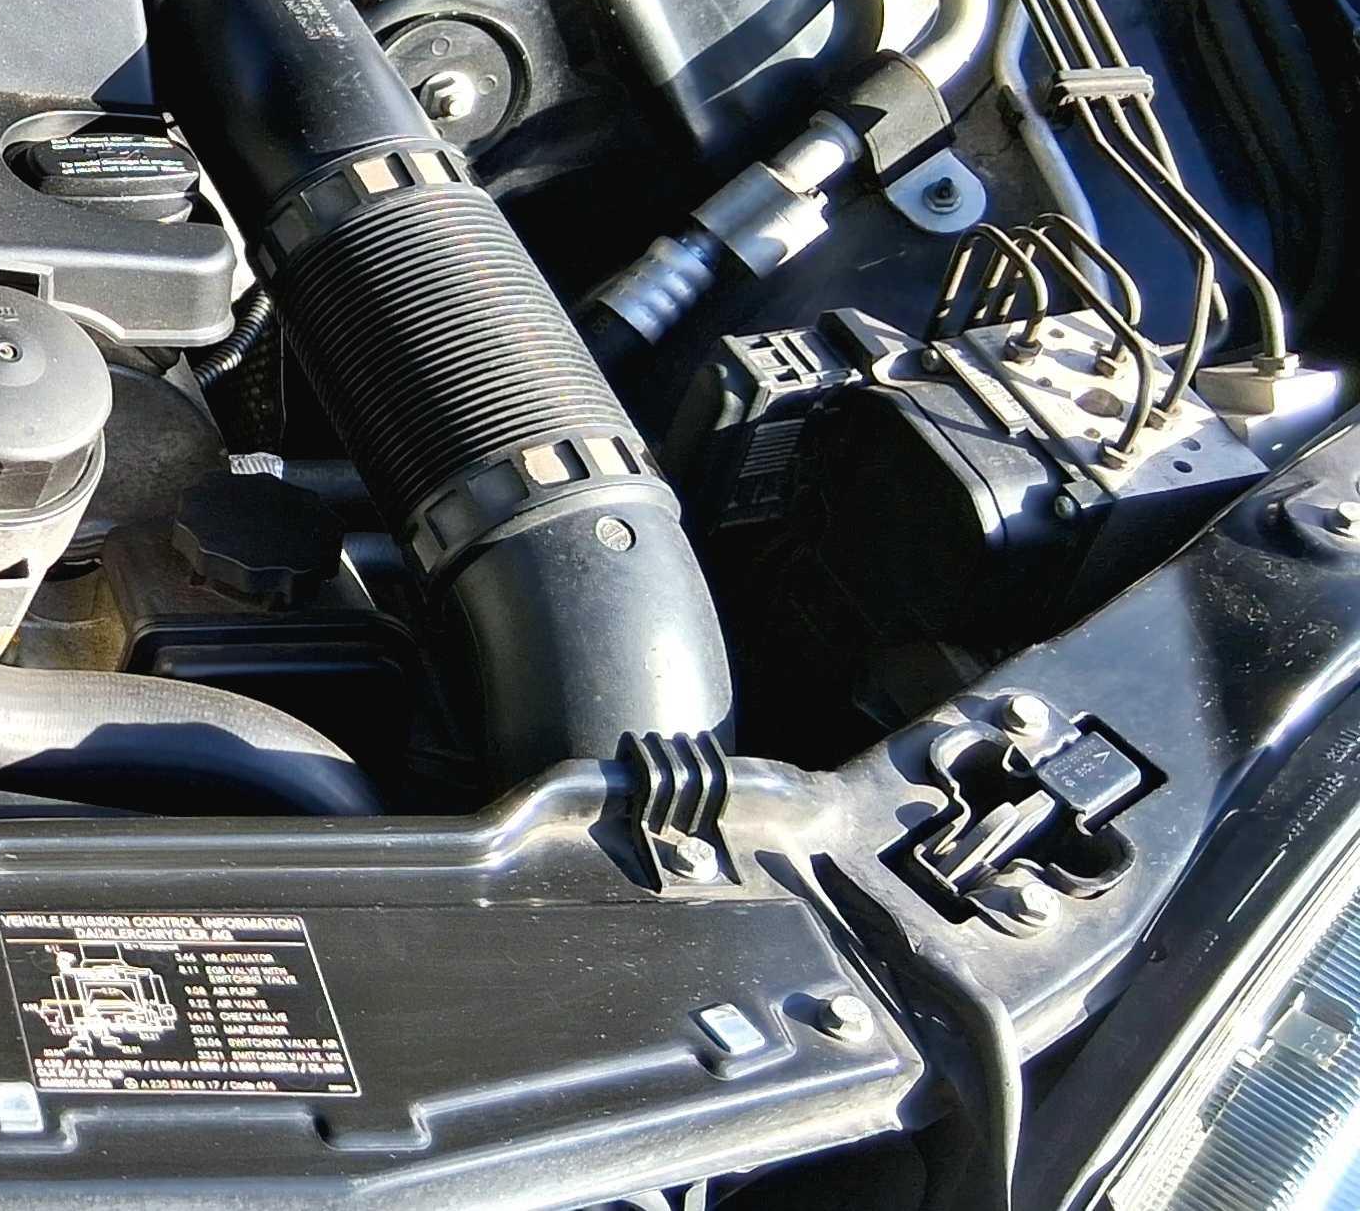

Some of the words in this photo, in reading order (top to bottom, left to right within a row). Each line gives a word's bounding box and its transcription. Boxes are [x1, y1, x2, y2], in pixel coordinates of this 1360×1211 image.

[0, 915, 59, 928] VEHICLE
[62, 915, 130, 928] EMISSION
[133, 917, 199, 929] CONTROL
[202, 917, 300, 931] INFORMATION
[75, 929, 209, 941] DAIMLERCHRYSLER
[212, 929, 234, 941] AG
[221, 954, 274, 963] ACTUATOR
[227, 966, 260, 975] VALVE
[261, 967, 288, 975] WITH
[265, 976, 298, 984] VALVE
[212, 987, 228, 996] AIR
[230, 987, 258, 996] PUMP
[216, 999, 232, 1008] AIR
[234, 1000, 268, 1009] VALVE
[219, 1012, 254, 1021] CHECK
[255, 1013, 289, 1022] VALVE
[223, 1025, 246, 1035] MAP
[248, 1026, 289, 1035] SENSOR
[228, 1038, 282, 1048] SWITCHING
[322, 1040, 339, 1049] AIR
[231, 1051, 286, 1060] SWITCHING
[327, 1052, 343, 1062] VIS
[141, 1080, 149, 1088] A
[230, 1081, 255, 1089] Code
